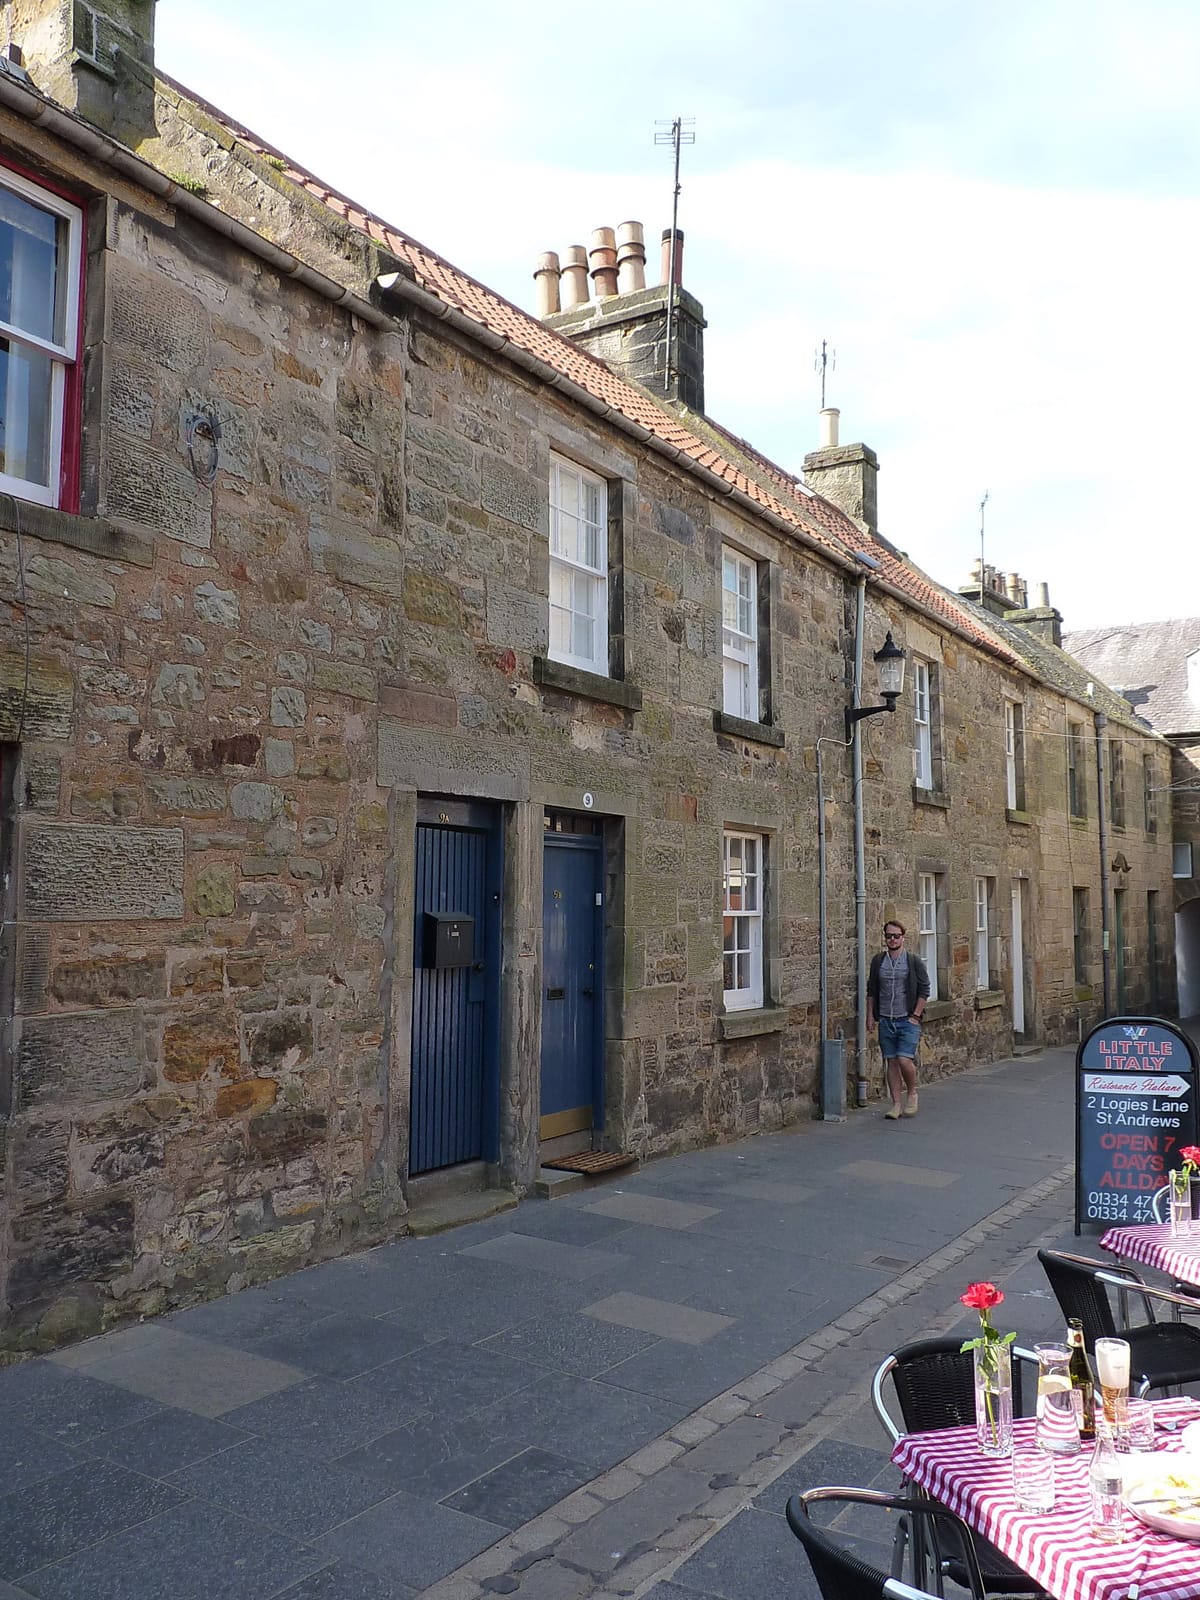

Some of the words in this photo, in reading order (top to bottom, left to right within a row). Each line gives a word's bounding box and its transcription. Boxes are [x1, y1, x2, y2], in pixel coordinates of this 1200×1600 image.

[1099, 1040, 1173, 1056] LITTLE
[1105, 1055, 1166, 1071] ITALY
[1088, 1076, 1138, 1091] Ristorante
[1087, 1096, 1096, 1108] 2
[1101, 1097, 1149, 1113] Logies
[1153, 1099, 1189, 1113] Lane
[1096, 1112, 1112, 1125] St
[1115, 1113, 1181, 1128] Andrews
[1100, 1132, 1158, 1152] OPEN
[1163, 1136, 1176, 1153] 7
[1112, 1152, 1164, 1171] DAYS
[1088, 1191, 1129, 1207] 01334
[1087, 1205, 1128, 1220] 01334
